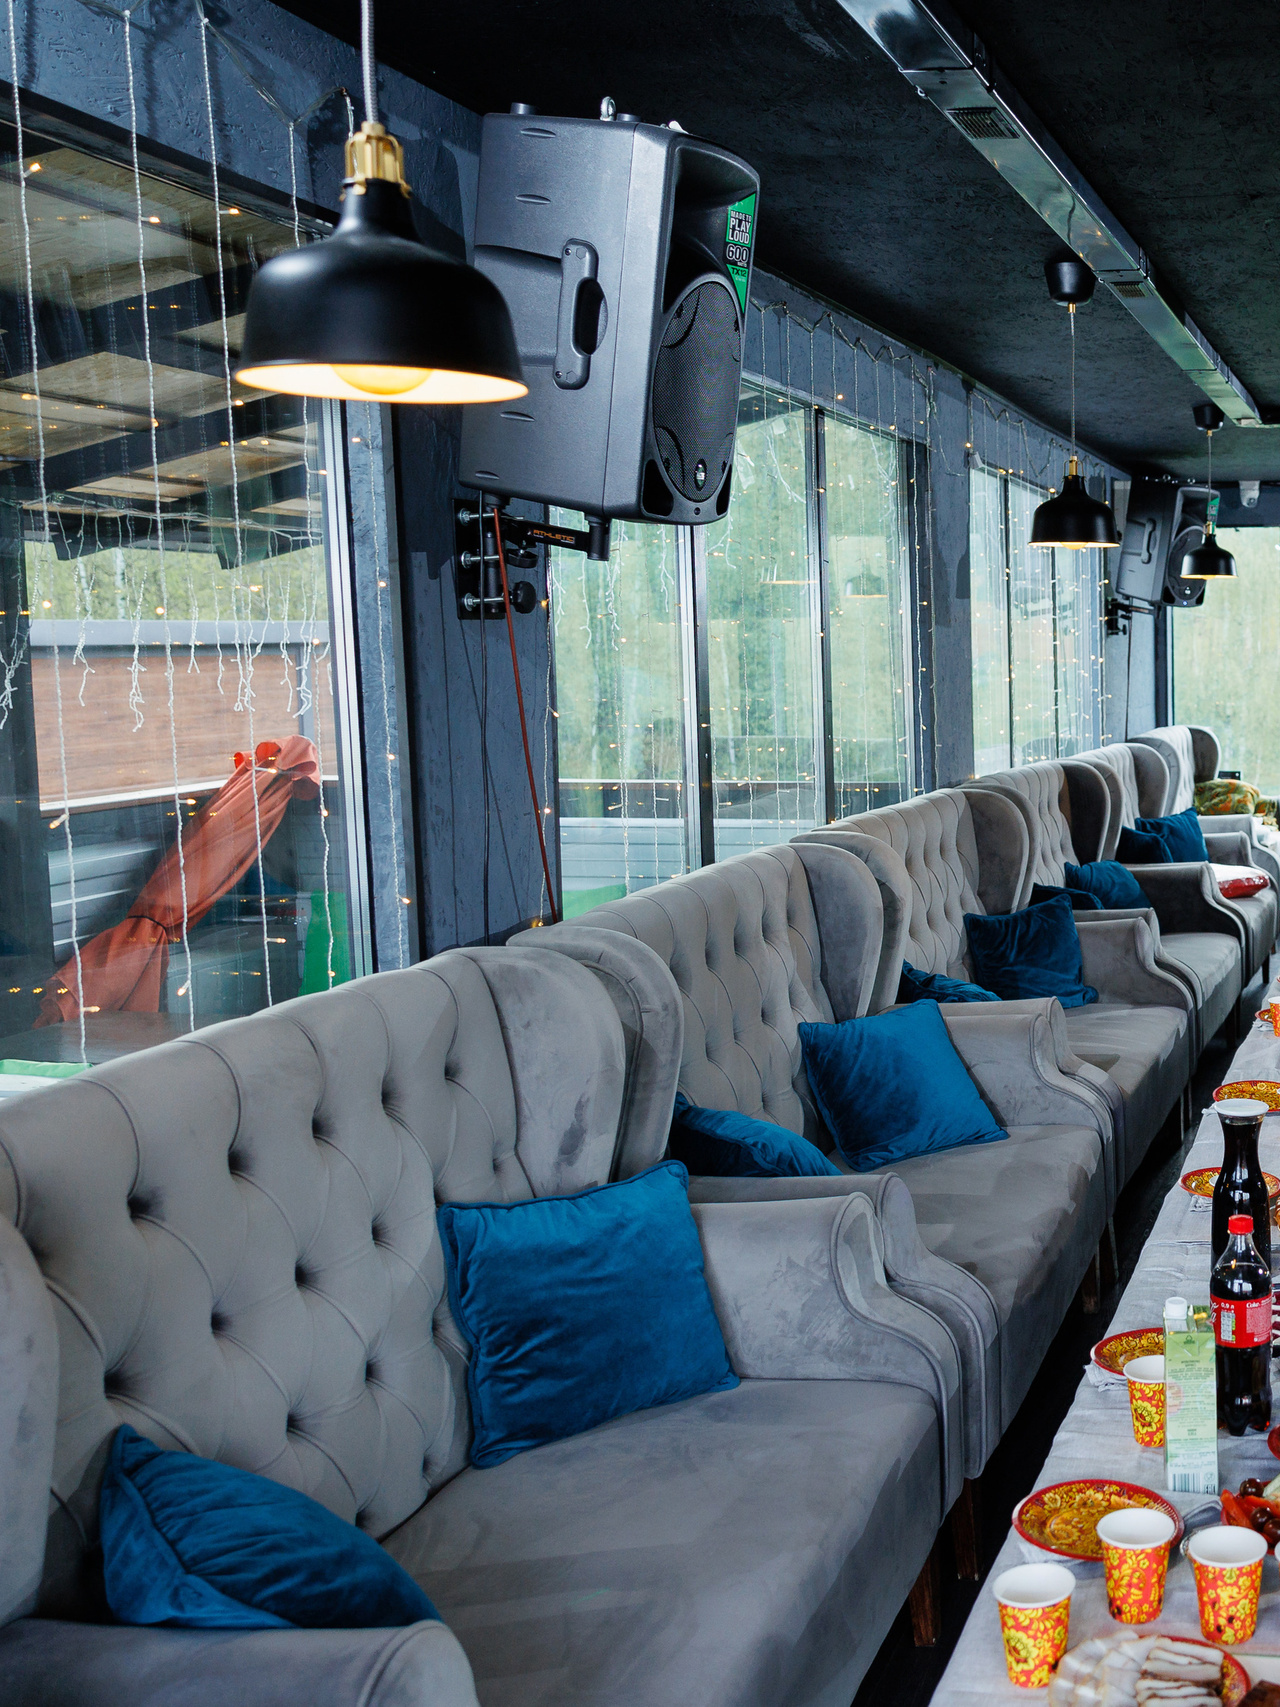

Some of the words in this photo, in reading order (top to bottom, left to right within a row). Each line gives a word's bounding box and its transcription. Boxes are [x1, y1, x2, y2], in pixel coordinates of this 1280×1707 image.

[730, 210, 746, 221] MADE
[730, 217, 751, 233] PLAY
[728, 229, 750, 244] LOUD
[726, 243, 749, 263] 600
[730, 266, 747, 278] TX12
